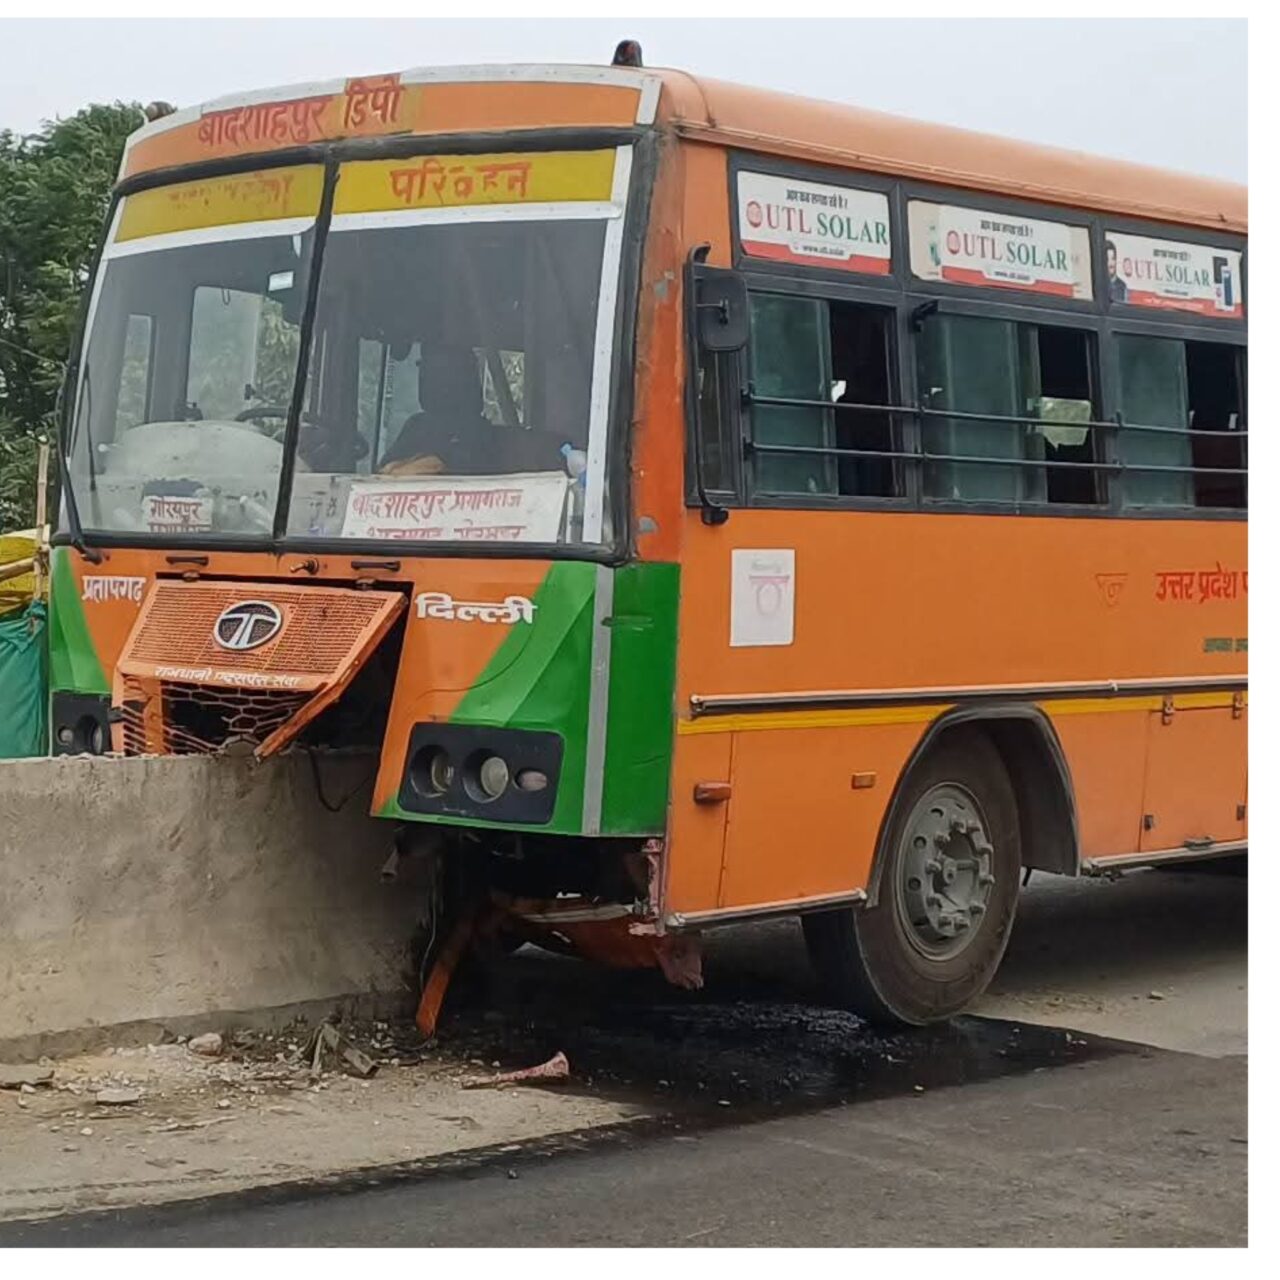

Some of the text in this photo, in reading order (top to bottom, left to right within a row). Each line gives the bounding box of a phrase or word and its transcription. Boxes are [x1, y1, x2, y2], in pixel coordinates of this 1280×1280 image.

[197, 75, 405, 146] बादशाहपुर डिपो
[766, 204, 888, 245] UTL SOLAR
[963, 233, 1068, 271] UTL SOLAR
[1135, 258, 1211, 287] UTL SOLAR
[81, 575, 146, 608] प्रतापगढ़
[415, 591, 538, 624] दिल्ली
